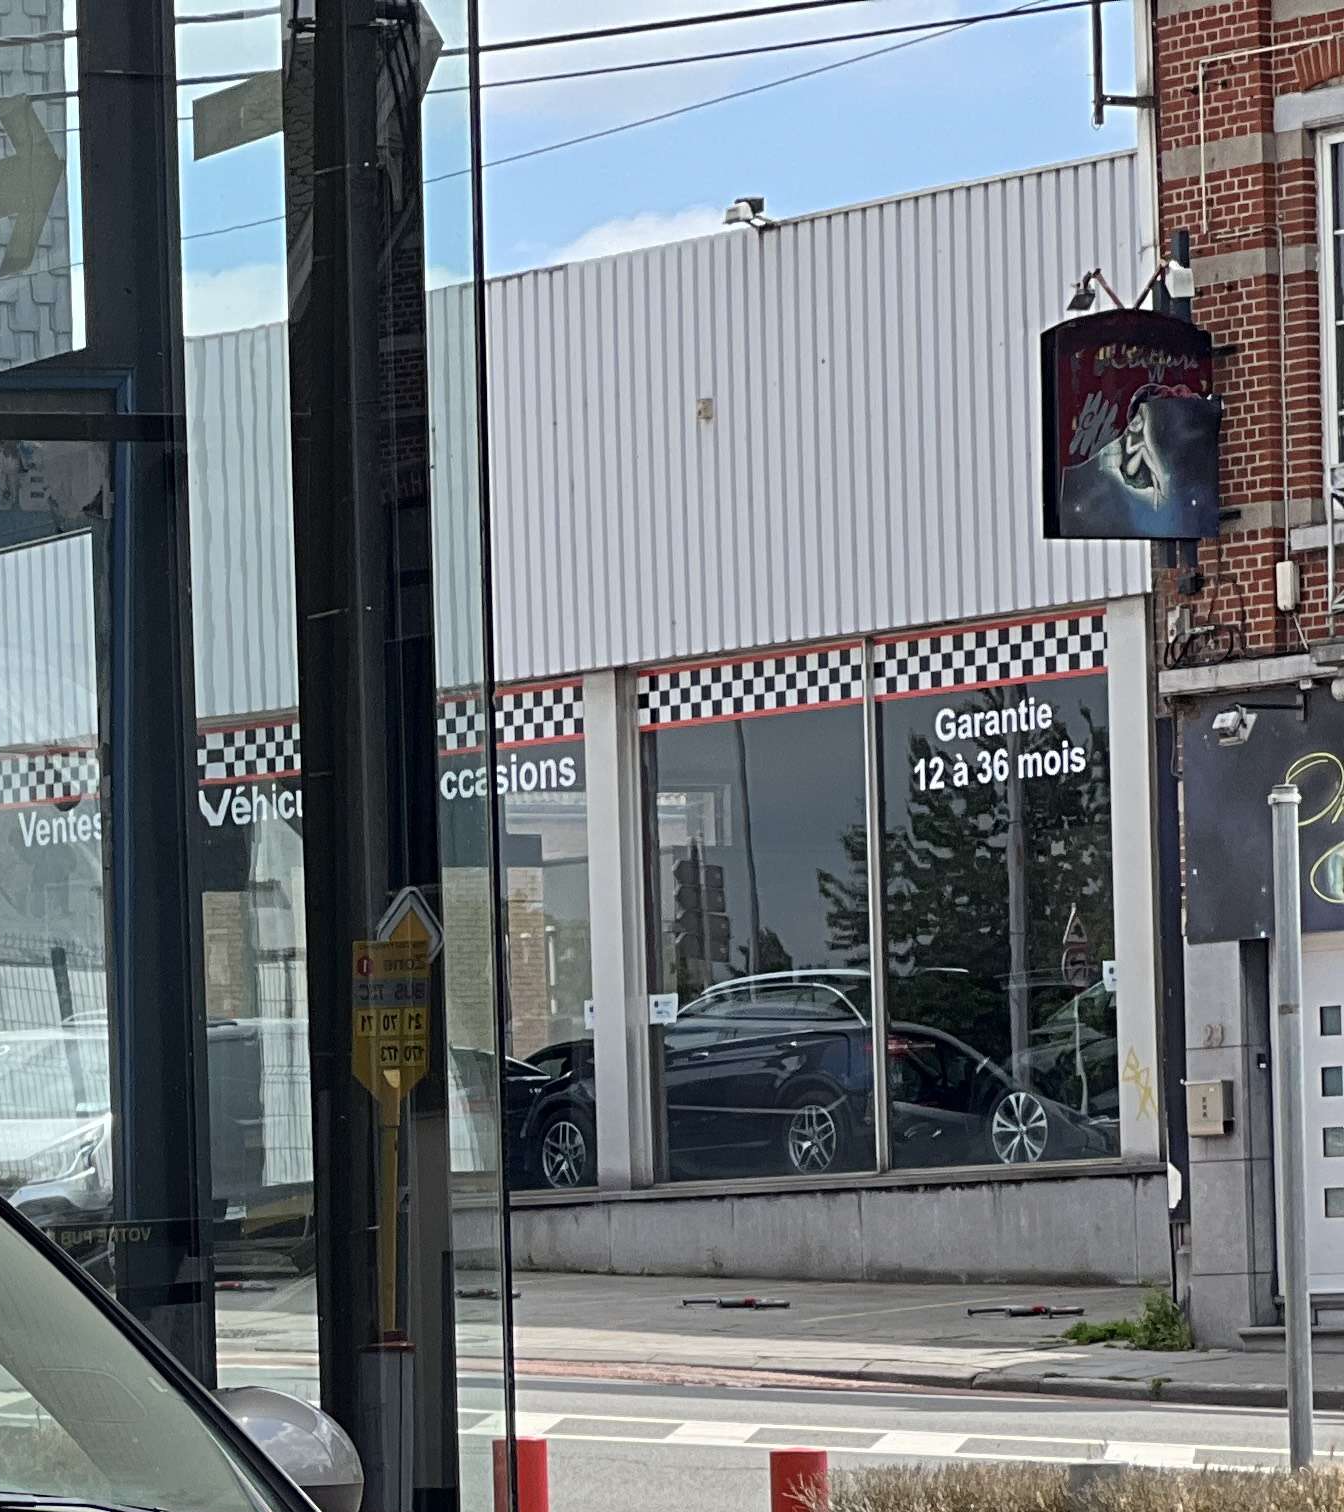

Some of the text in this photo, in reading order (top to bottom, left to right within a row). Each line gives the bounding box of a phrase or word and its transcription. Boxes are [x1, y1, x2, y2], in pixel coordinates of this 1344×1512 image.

[935, 697, 1053, 742] Garantie
[440, 753, 577, 800] ccasions
[914, 740, 1086, 791] 12 à 36 mois
